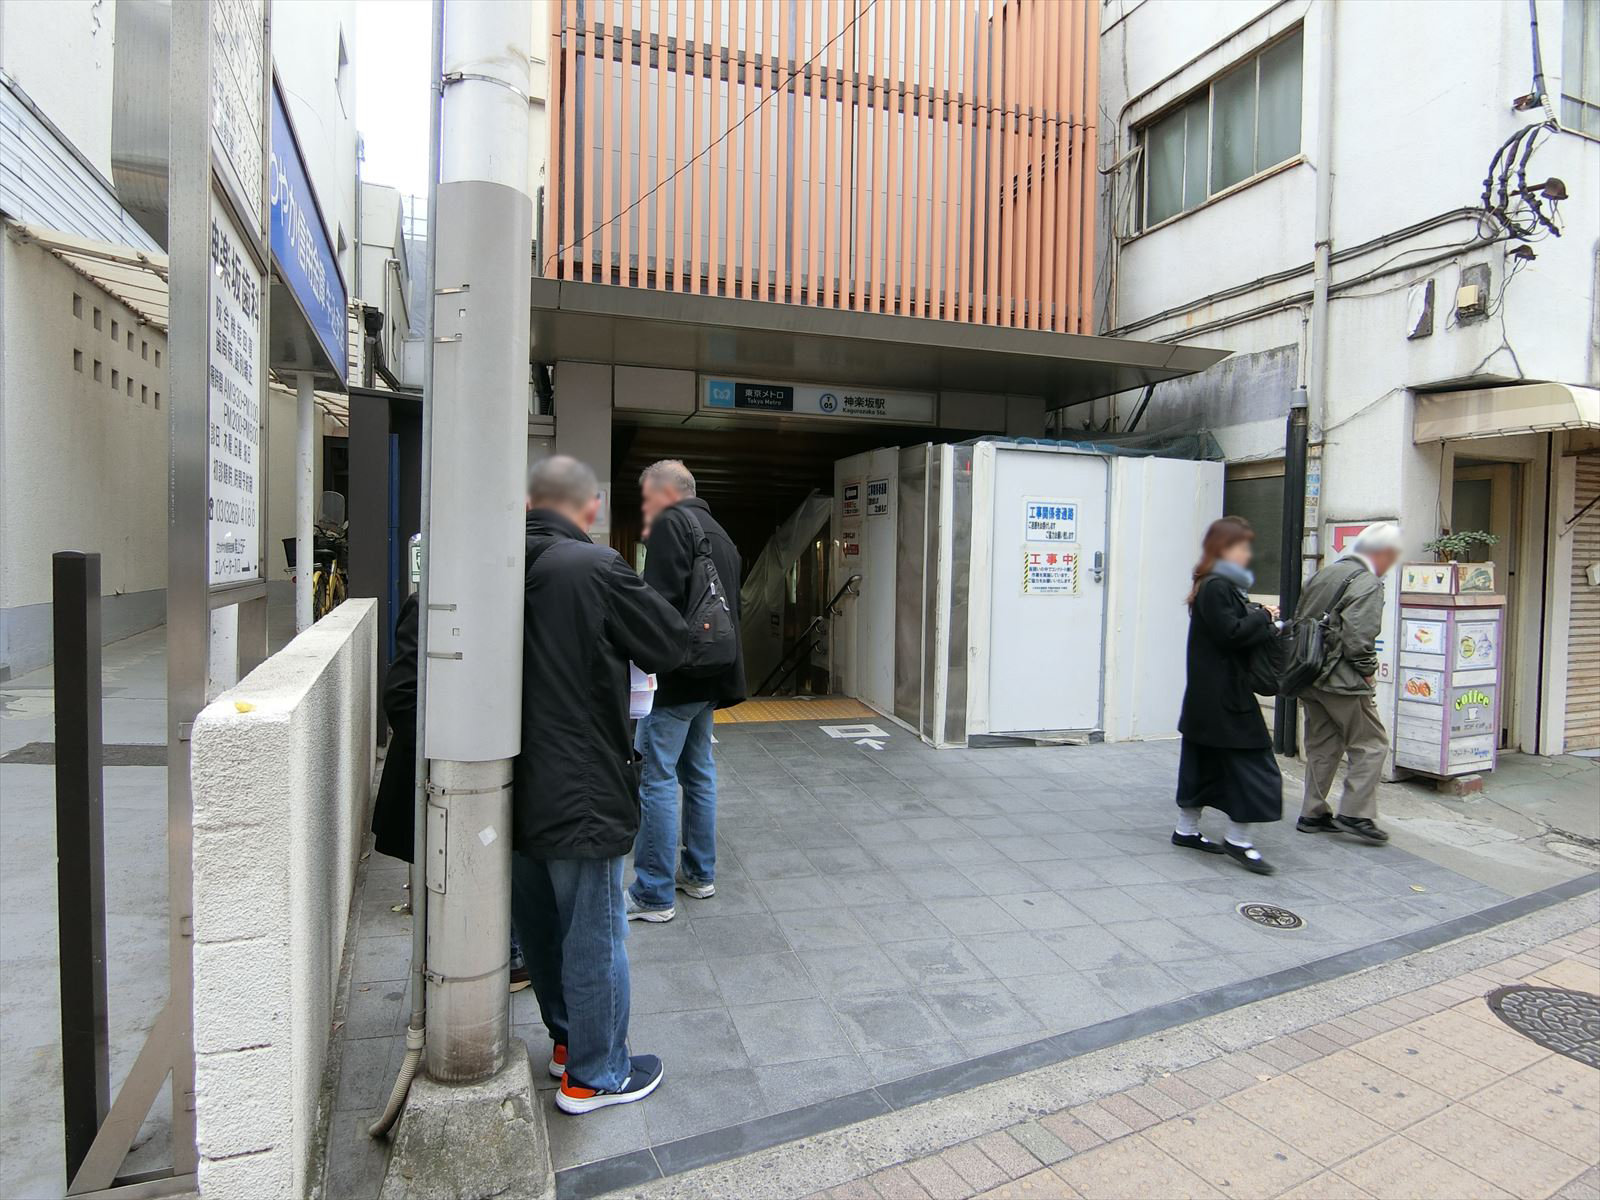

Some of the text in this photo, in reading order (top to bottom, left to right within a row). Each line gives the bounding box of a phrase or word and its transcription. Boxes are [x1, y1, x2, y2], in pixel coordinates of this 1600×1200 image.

[745, 388, 784, 399] 東京メトロ
[844, 396, 885, 409] 神楽坂駅
[842, 407, 876, 416] Kagurazaka
[1030, 553, 1073, 566] 工事中
